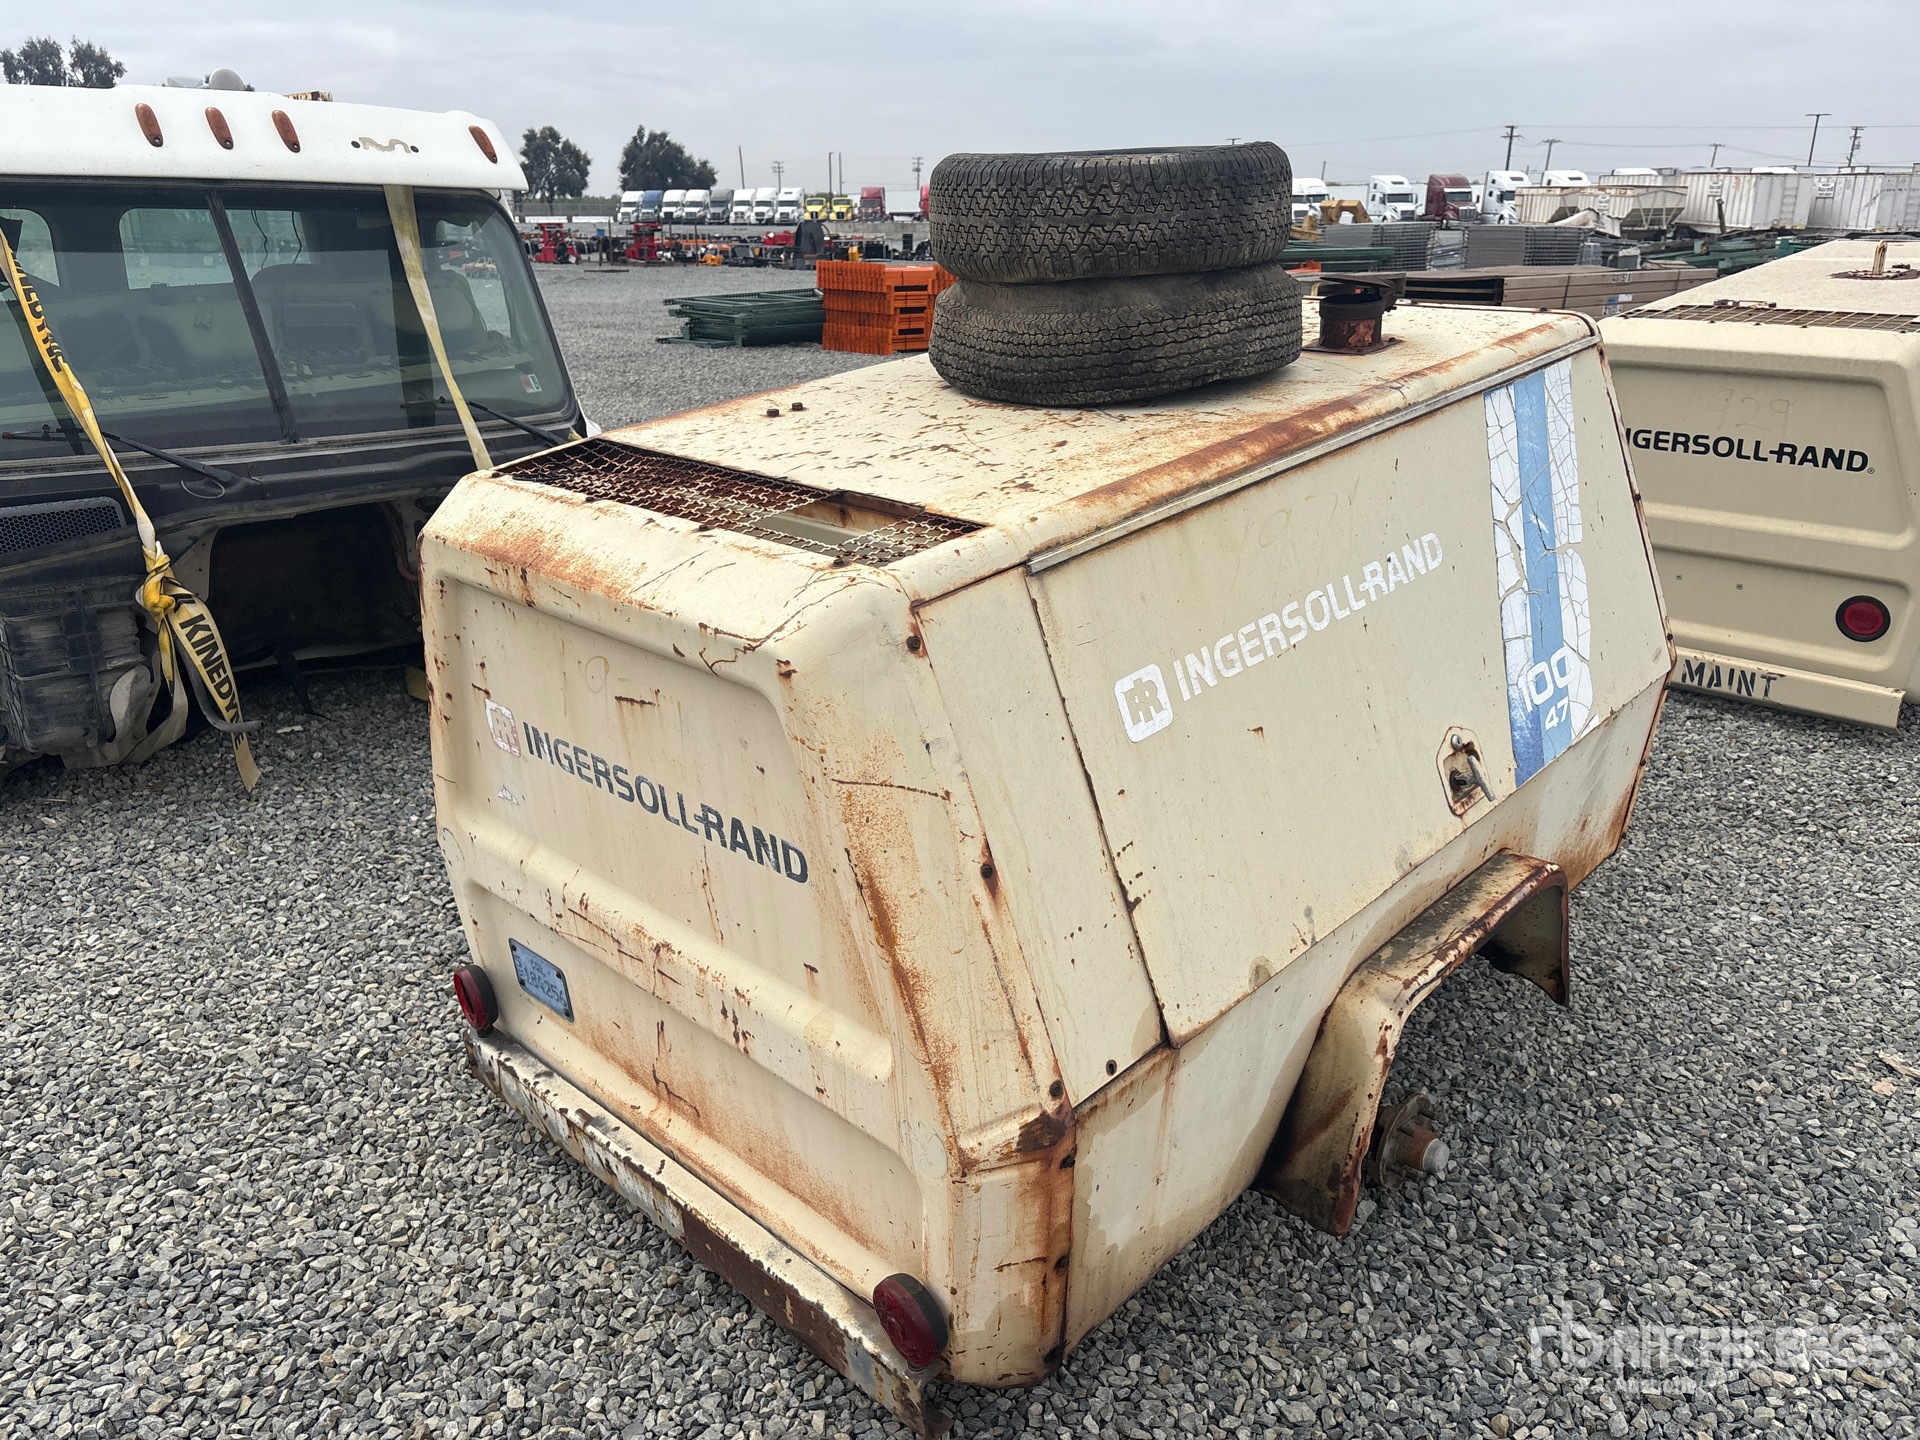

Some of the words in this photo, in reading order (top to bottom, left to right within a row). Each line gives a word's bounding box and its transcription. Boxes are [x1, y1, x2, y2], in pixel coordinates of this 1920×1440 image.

[1172, 532, 1444, 702] INGERSOLL-RAND
[1517, 646, 1576, 713] 100
[1681, 659, 1778, 701] MAINT
[1544, 695, 1569, 732] 47
[523, 721, 809, 884] INGERSOLL-RAND
